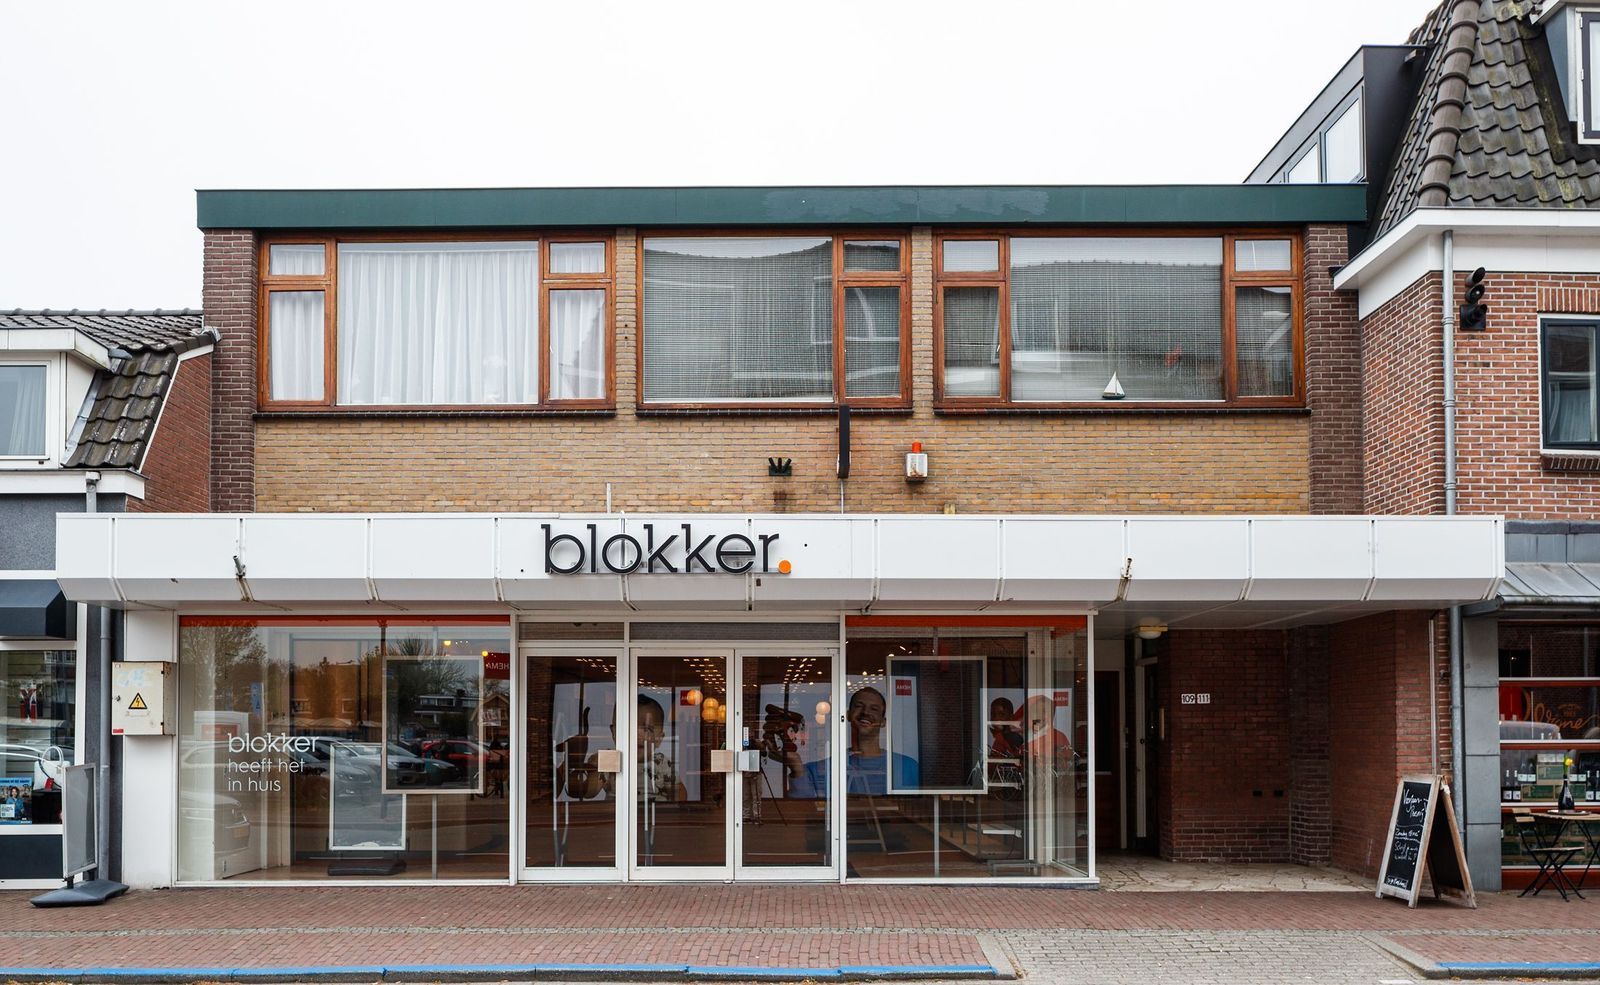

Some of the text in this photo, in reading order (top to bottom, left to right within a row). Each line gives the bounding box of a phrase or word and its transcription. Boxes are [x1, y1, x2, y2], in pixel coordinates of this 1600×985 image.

[1182, 694, 1209, 703] 109 111
[228, 733, 319, 752] blokker
[228, 758, 305, 773] heeft het
[228, 777, 281, 792] in huis
